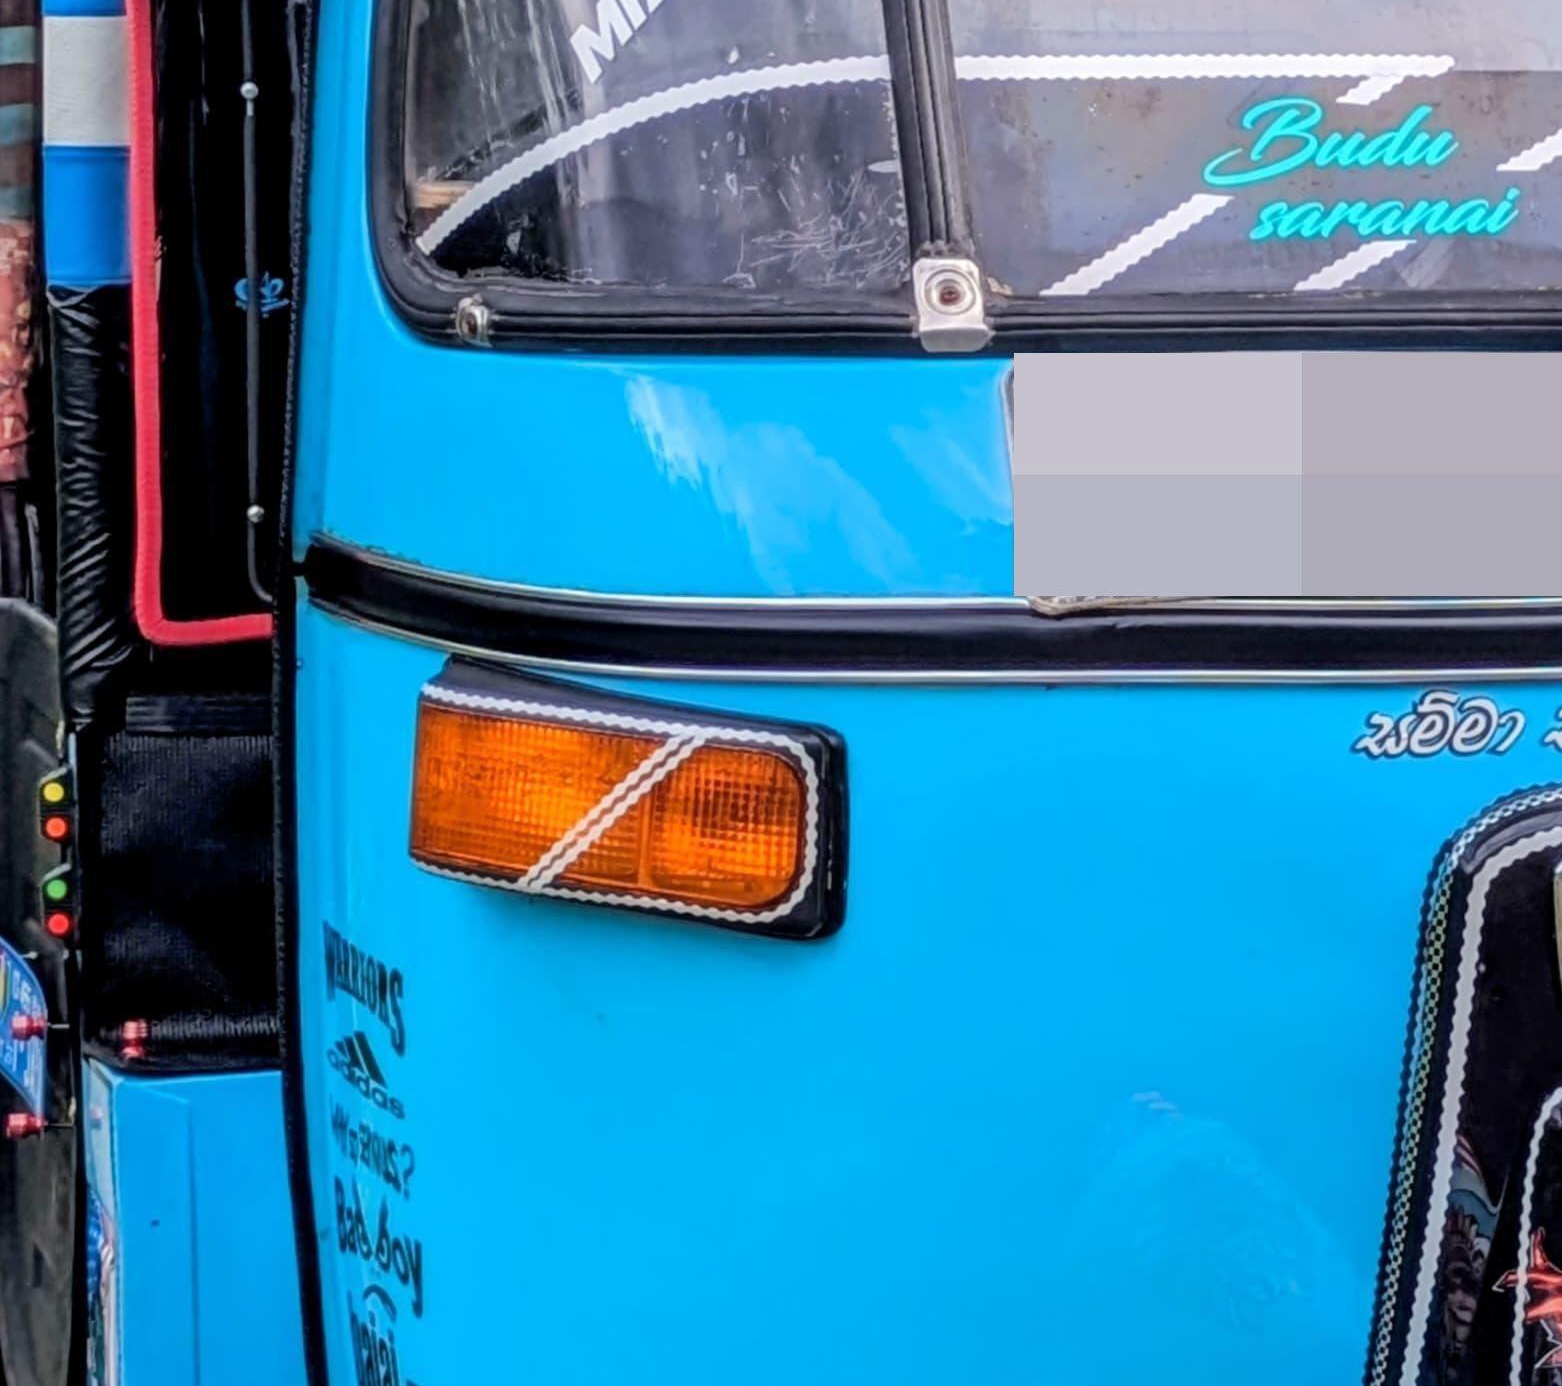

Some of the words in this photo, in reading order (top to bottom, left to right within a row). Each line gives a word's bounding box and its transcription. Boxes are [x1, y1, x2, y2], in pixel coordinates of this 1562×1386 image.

[1202, 96, 1460, 188] Budu
[1248, 186, 1521, 242] saranai
[325, 1046, 406, 1120] adidas
